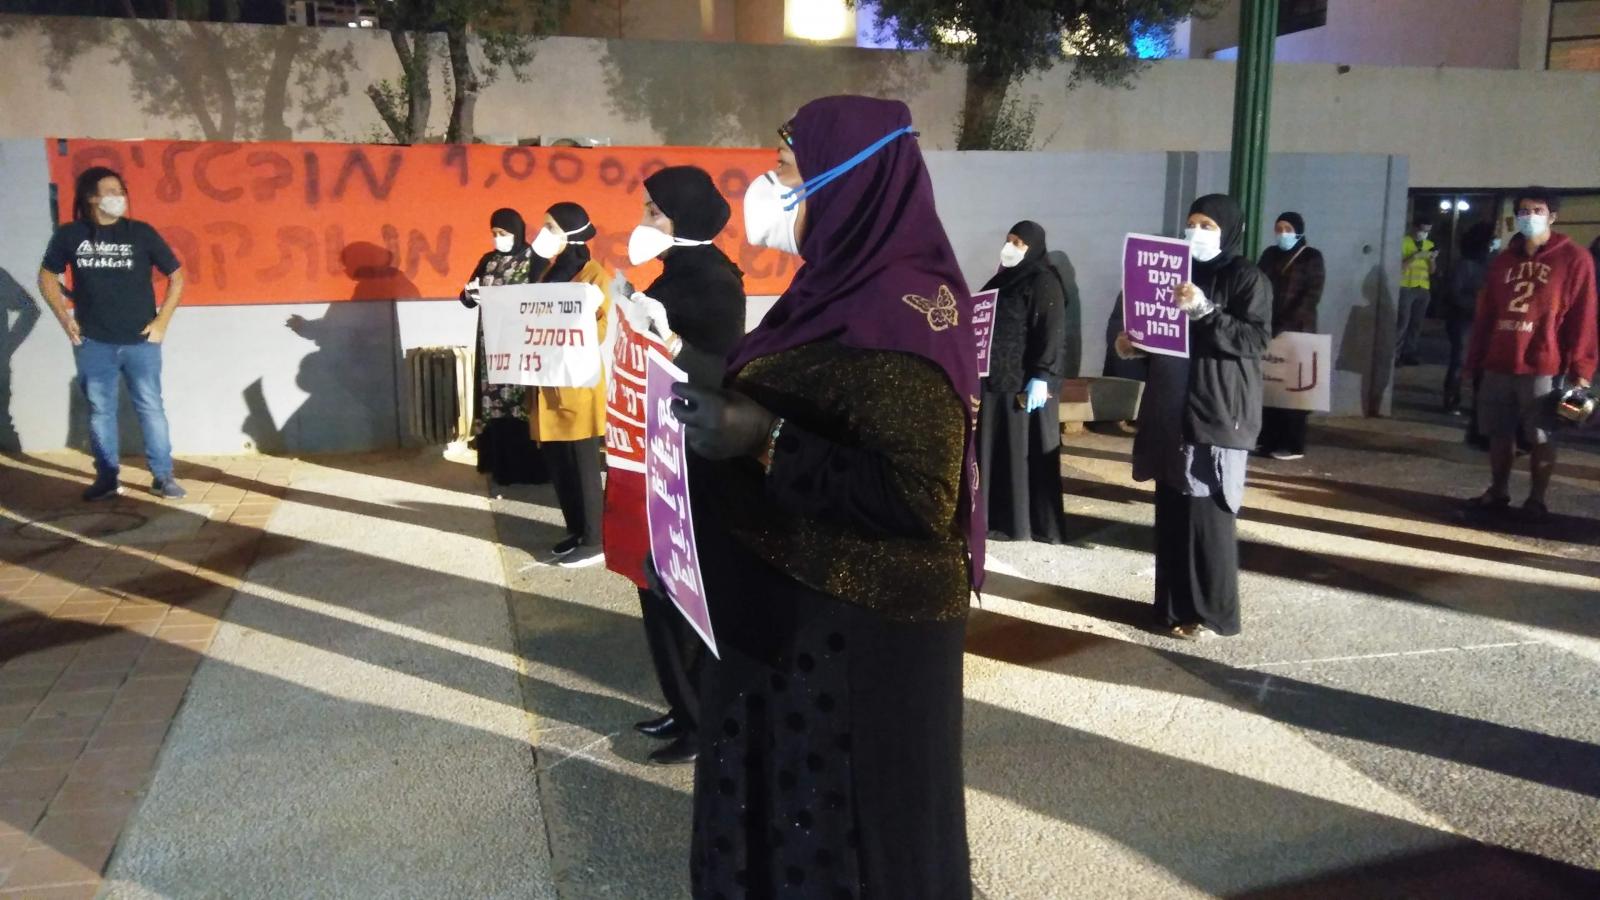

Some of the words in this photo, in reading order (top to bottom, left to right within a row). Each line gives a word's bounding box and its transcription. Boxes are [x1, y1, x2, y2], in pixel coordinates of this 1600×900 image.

[443, 144, 749, 198] 1,000,0
[1137, 250, 1183, 270] שלטון
[1148, 269, 1181, 287] העם
[1504, 261, 1552, 284] LIVE
[558, 300, 582, 314] השר
[1507, 281, 1535, 313] 2
[519, 301, 554, 317] אקוניס
[1134, 300, 1180, 321] שלטון
[524, 324, 585, 347] תסתכל
[1146, 319, 1180, 338] ההון
[519, 351, 542, 372] לנו
